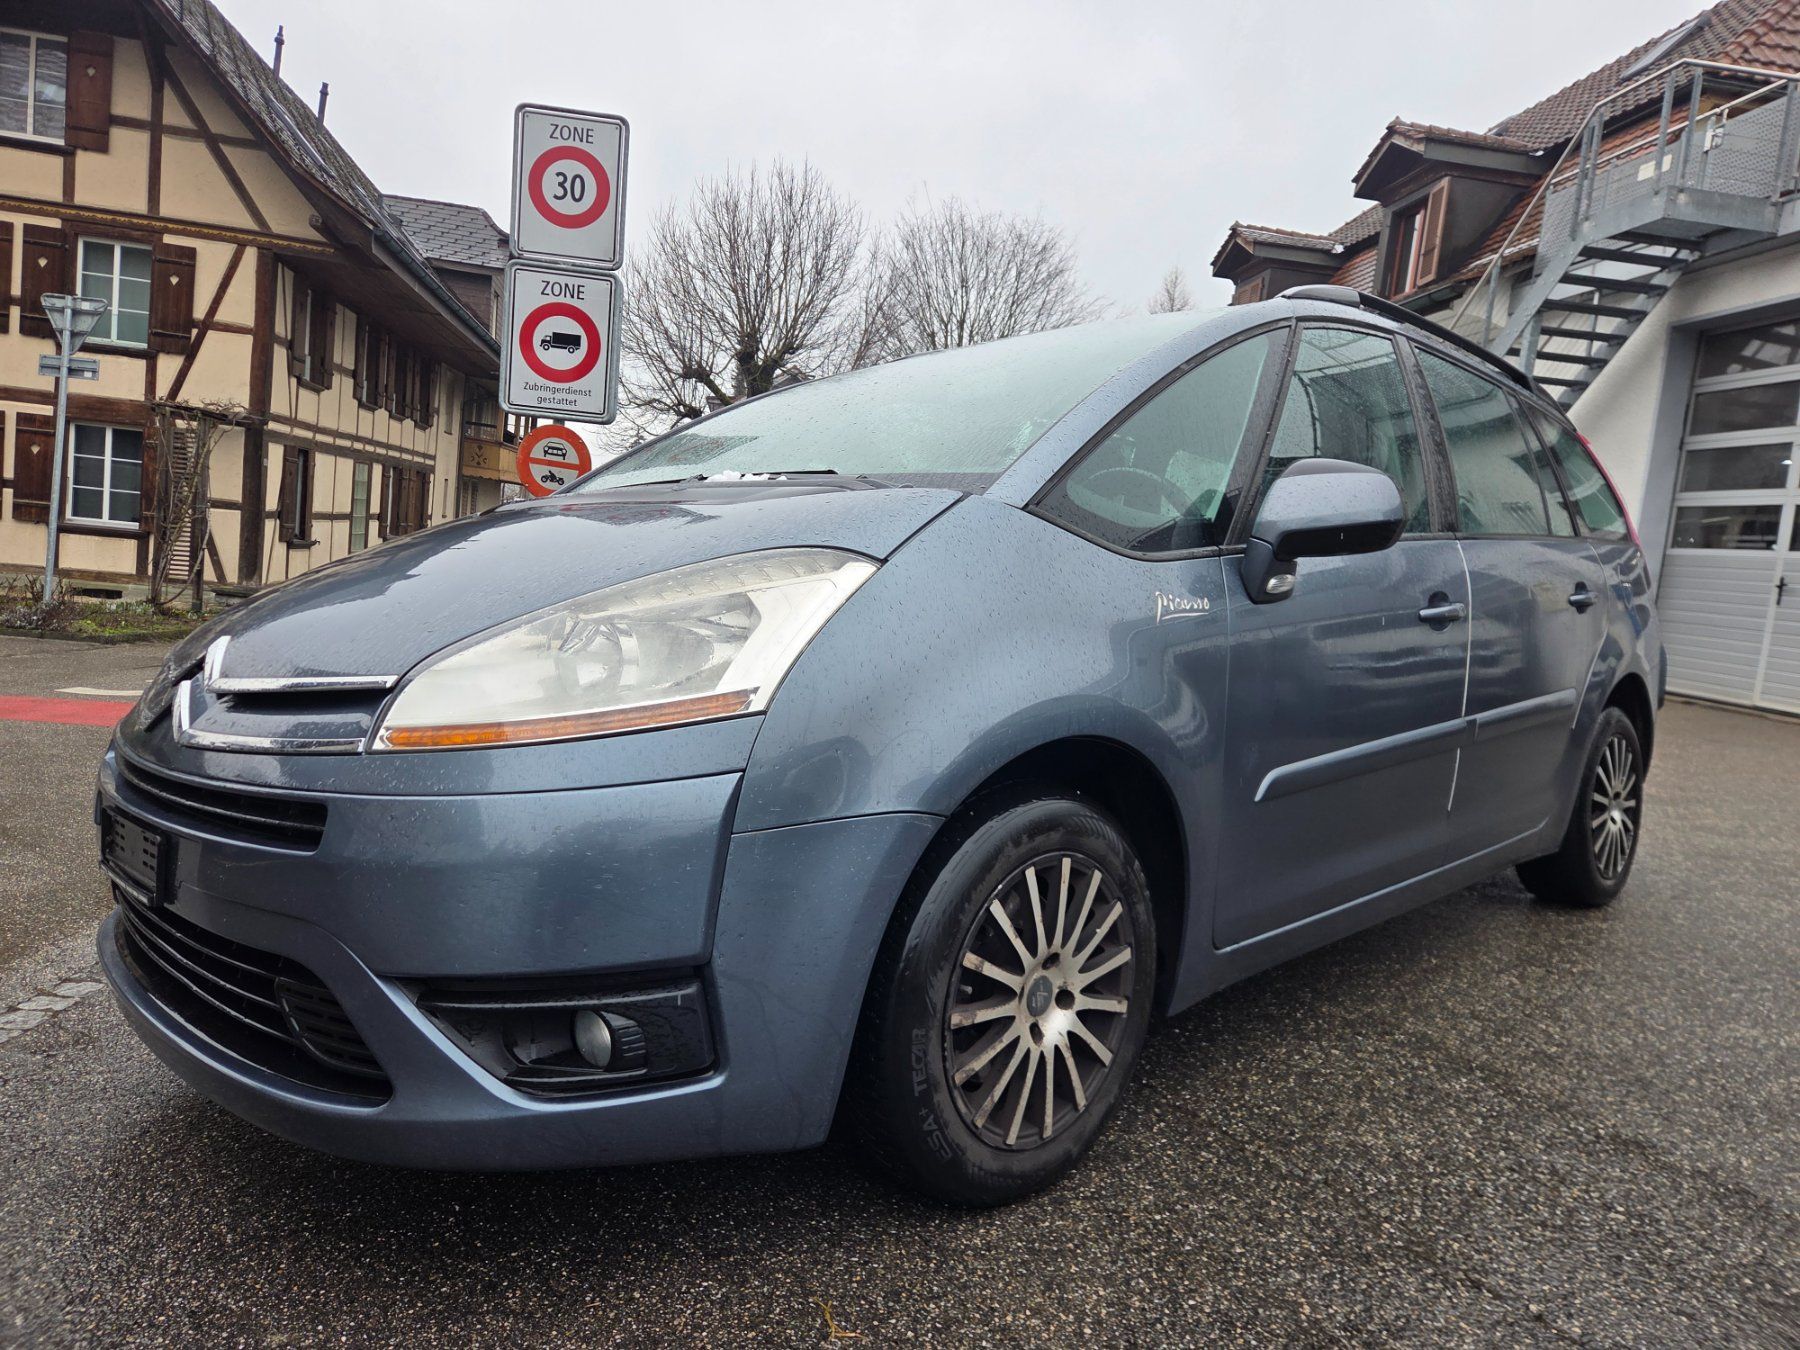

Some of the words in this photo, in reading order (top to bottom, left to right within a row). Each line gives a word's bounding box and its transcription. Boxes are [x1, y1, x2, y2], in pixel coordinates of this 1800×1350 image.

[549, 123, 594, 144] ZONE
[552, 171, 586, 203] 30
[540, 280, 585, 300] ZONE
[523, 382, 592, 397] Zubringerdienst
[537, 396, 578, 407] gestattet
[1155, 591, 1210, 625] Picasso
